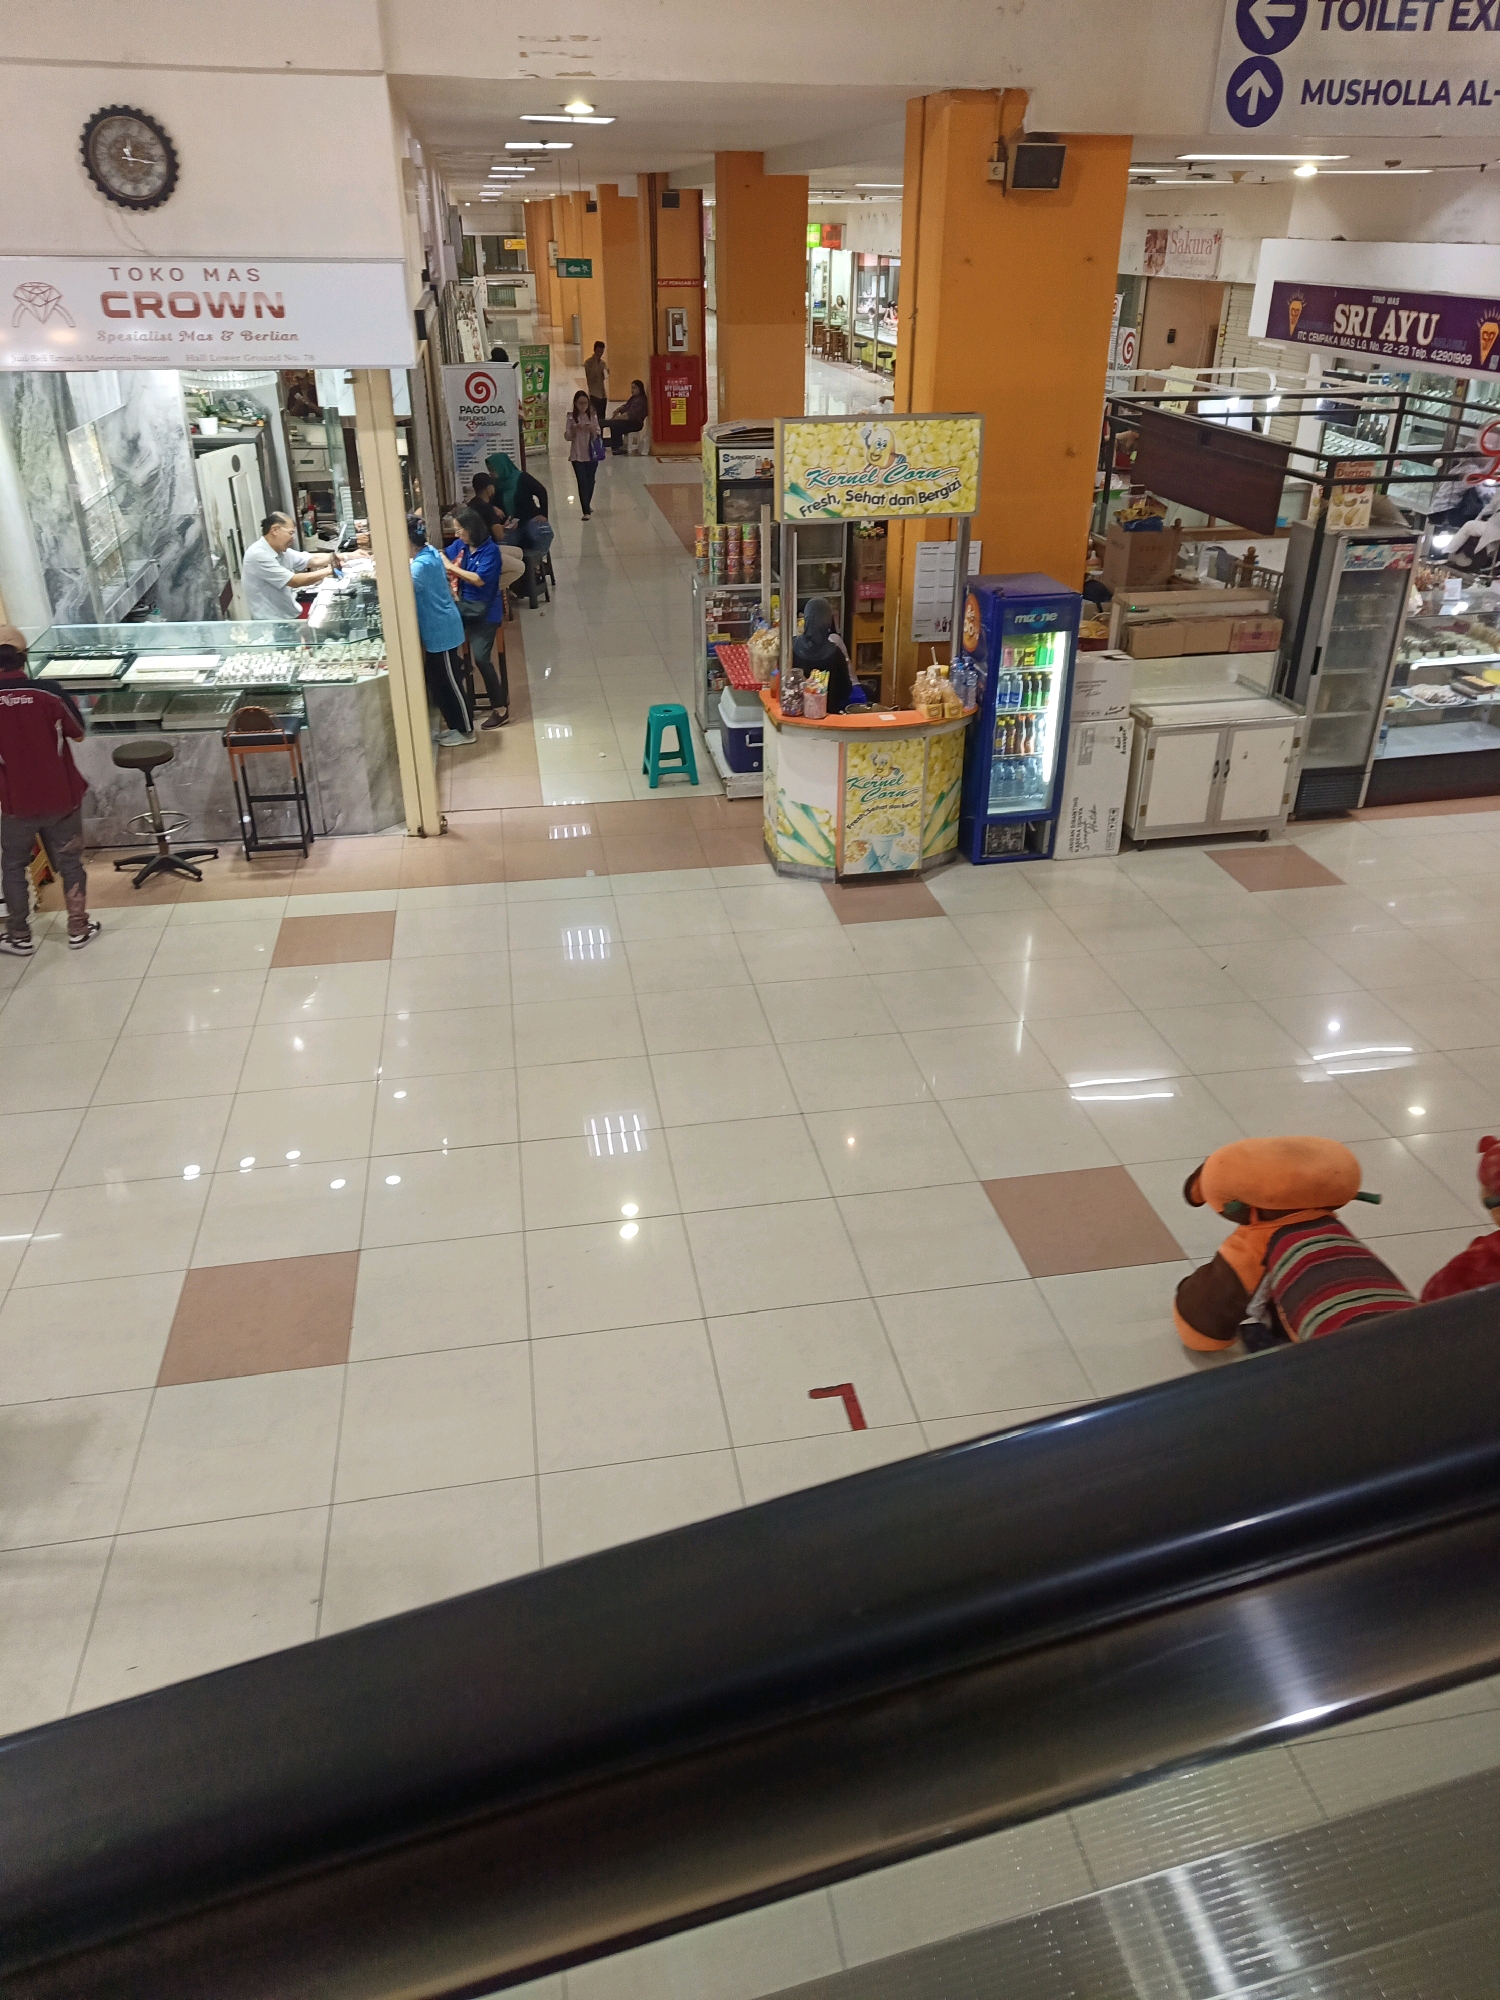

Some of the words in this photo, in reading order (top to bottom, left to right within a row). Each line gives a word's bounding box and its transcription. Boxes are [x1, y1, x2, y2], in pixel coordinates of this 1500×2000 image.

[1318, 0, 1445, 31] TOILET
[1300, 79, 1451, 106] MUSHOLLA
[1169, 230, 1214, 255] Sakura
[108, 266, 185, 282] TOKO
[203, 267, 261, 282] MAS
[100, 290, 286, 319] CROWN
[1333, 303, 1378, 339] SRI
[1378, 309, 1441, 346] AYU
[97, 330, 173, 344] Spesialist
[179, 330, 214, 343] Mas
[240, 330, 299, 342] Berlian
[1308, 332, 1340, 347] CEMPAKA
[1430, 349, 1473, 365] 42901909
[459, 405, 506, 415] PAGODA
[806, 467, 880, 487] Kernel
[883, 463, 959, 483] Corn
[799, 491, 841, 518] Fresh,
[845, 490, 886, 505] Sehat
[889, 493, 915, 506] dan
[918, 477, 963, 504] Bergizi
[1014, 612, 1059, 625] mizone
[847, 773, 905, 791] Kernel
[861, 787, 920, 803] Corn
[1068, 829, 1076, 853] JANGAN
